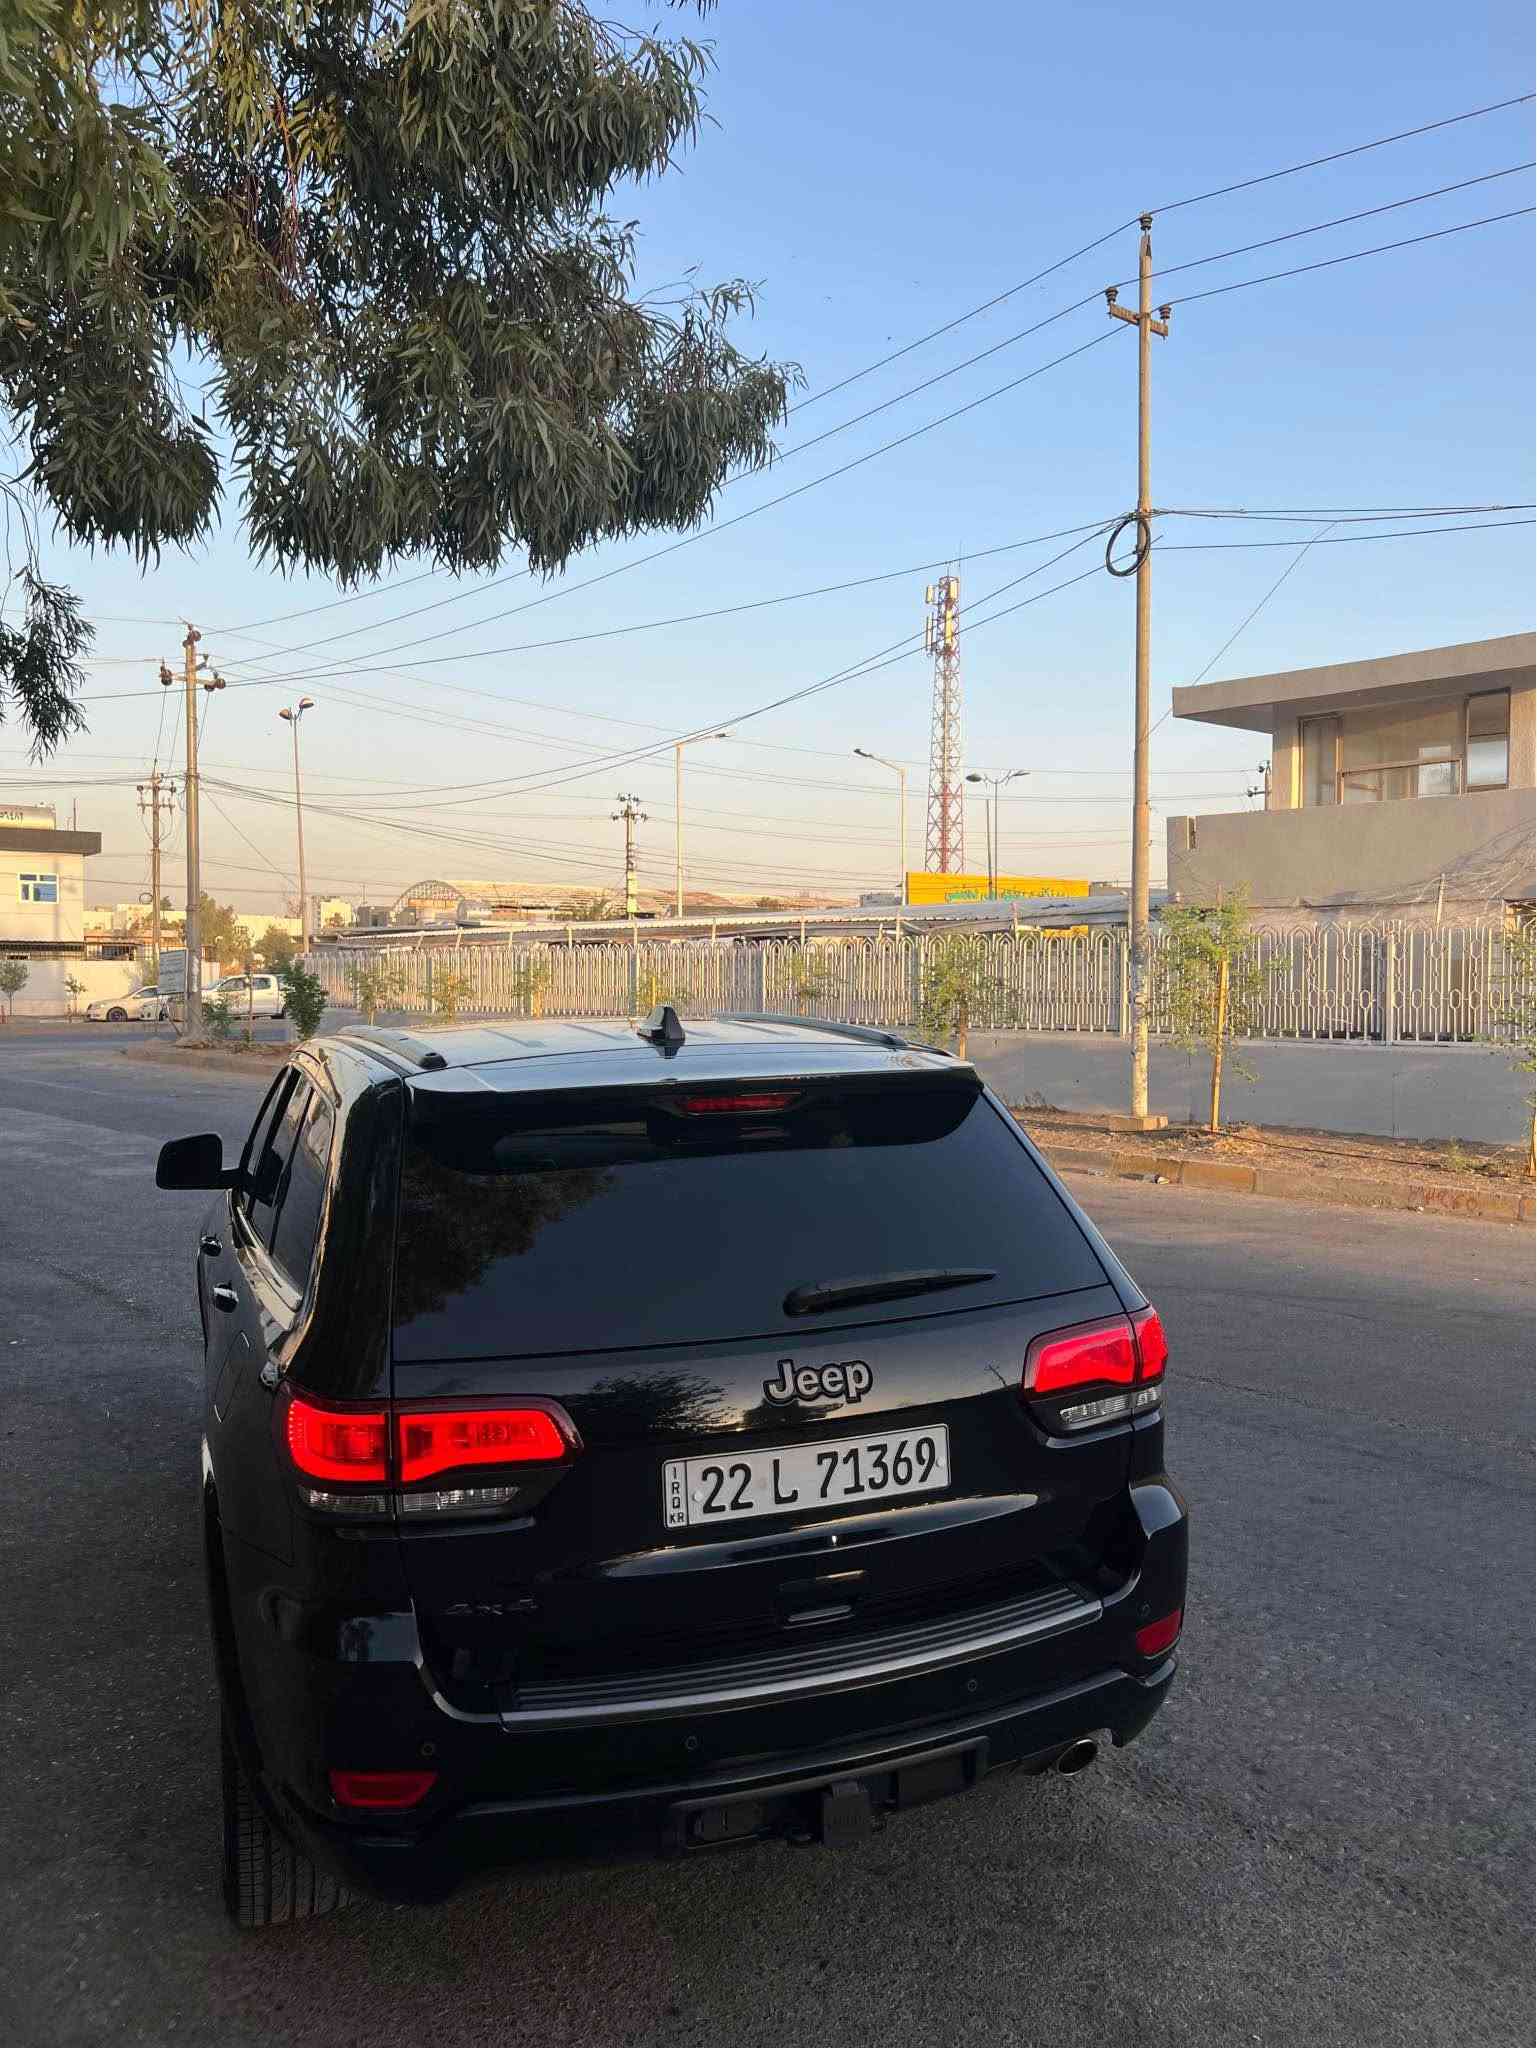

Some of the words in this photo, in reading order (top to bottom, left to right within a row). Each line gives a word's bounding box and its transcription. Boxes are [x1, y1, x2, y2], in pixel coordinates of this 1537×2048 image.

[764, 1359, 873, 1403] Jeep
[702, 1463, 754, 1514] 22
[772, 1458, 799, 1505] L
[816, 1437, 937, 1499] 71369
